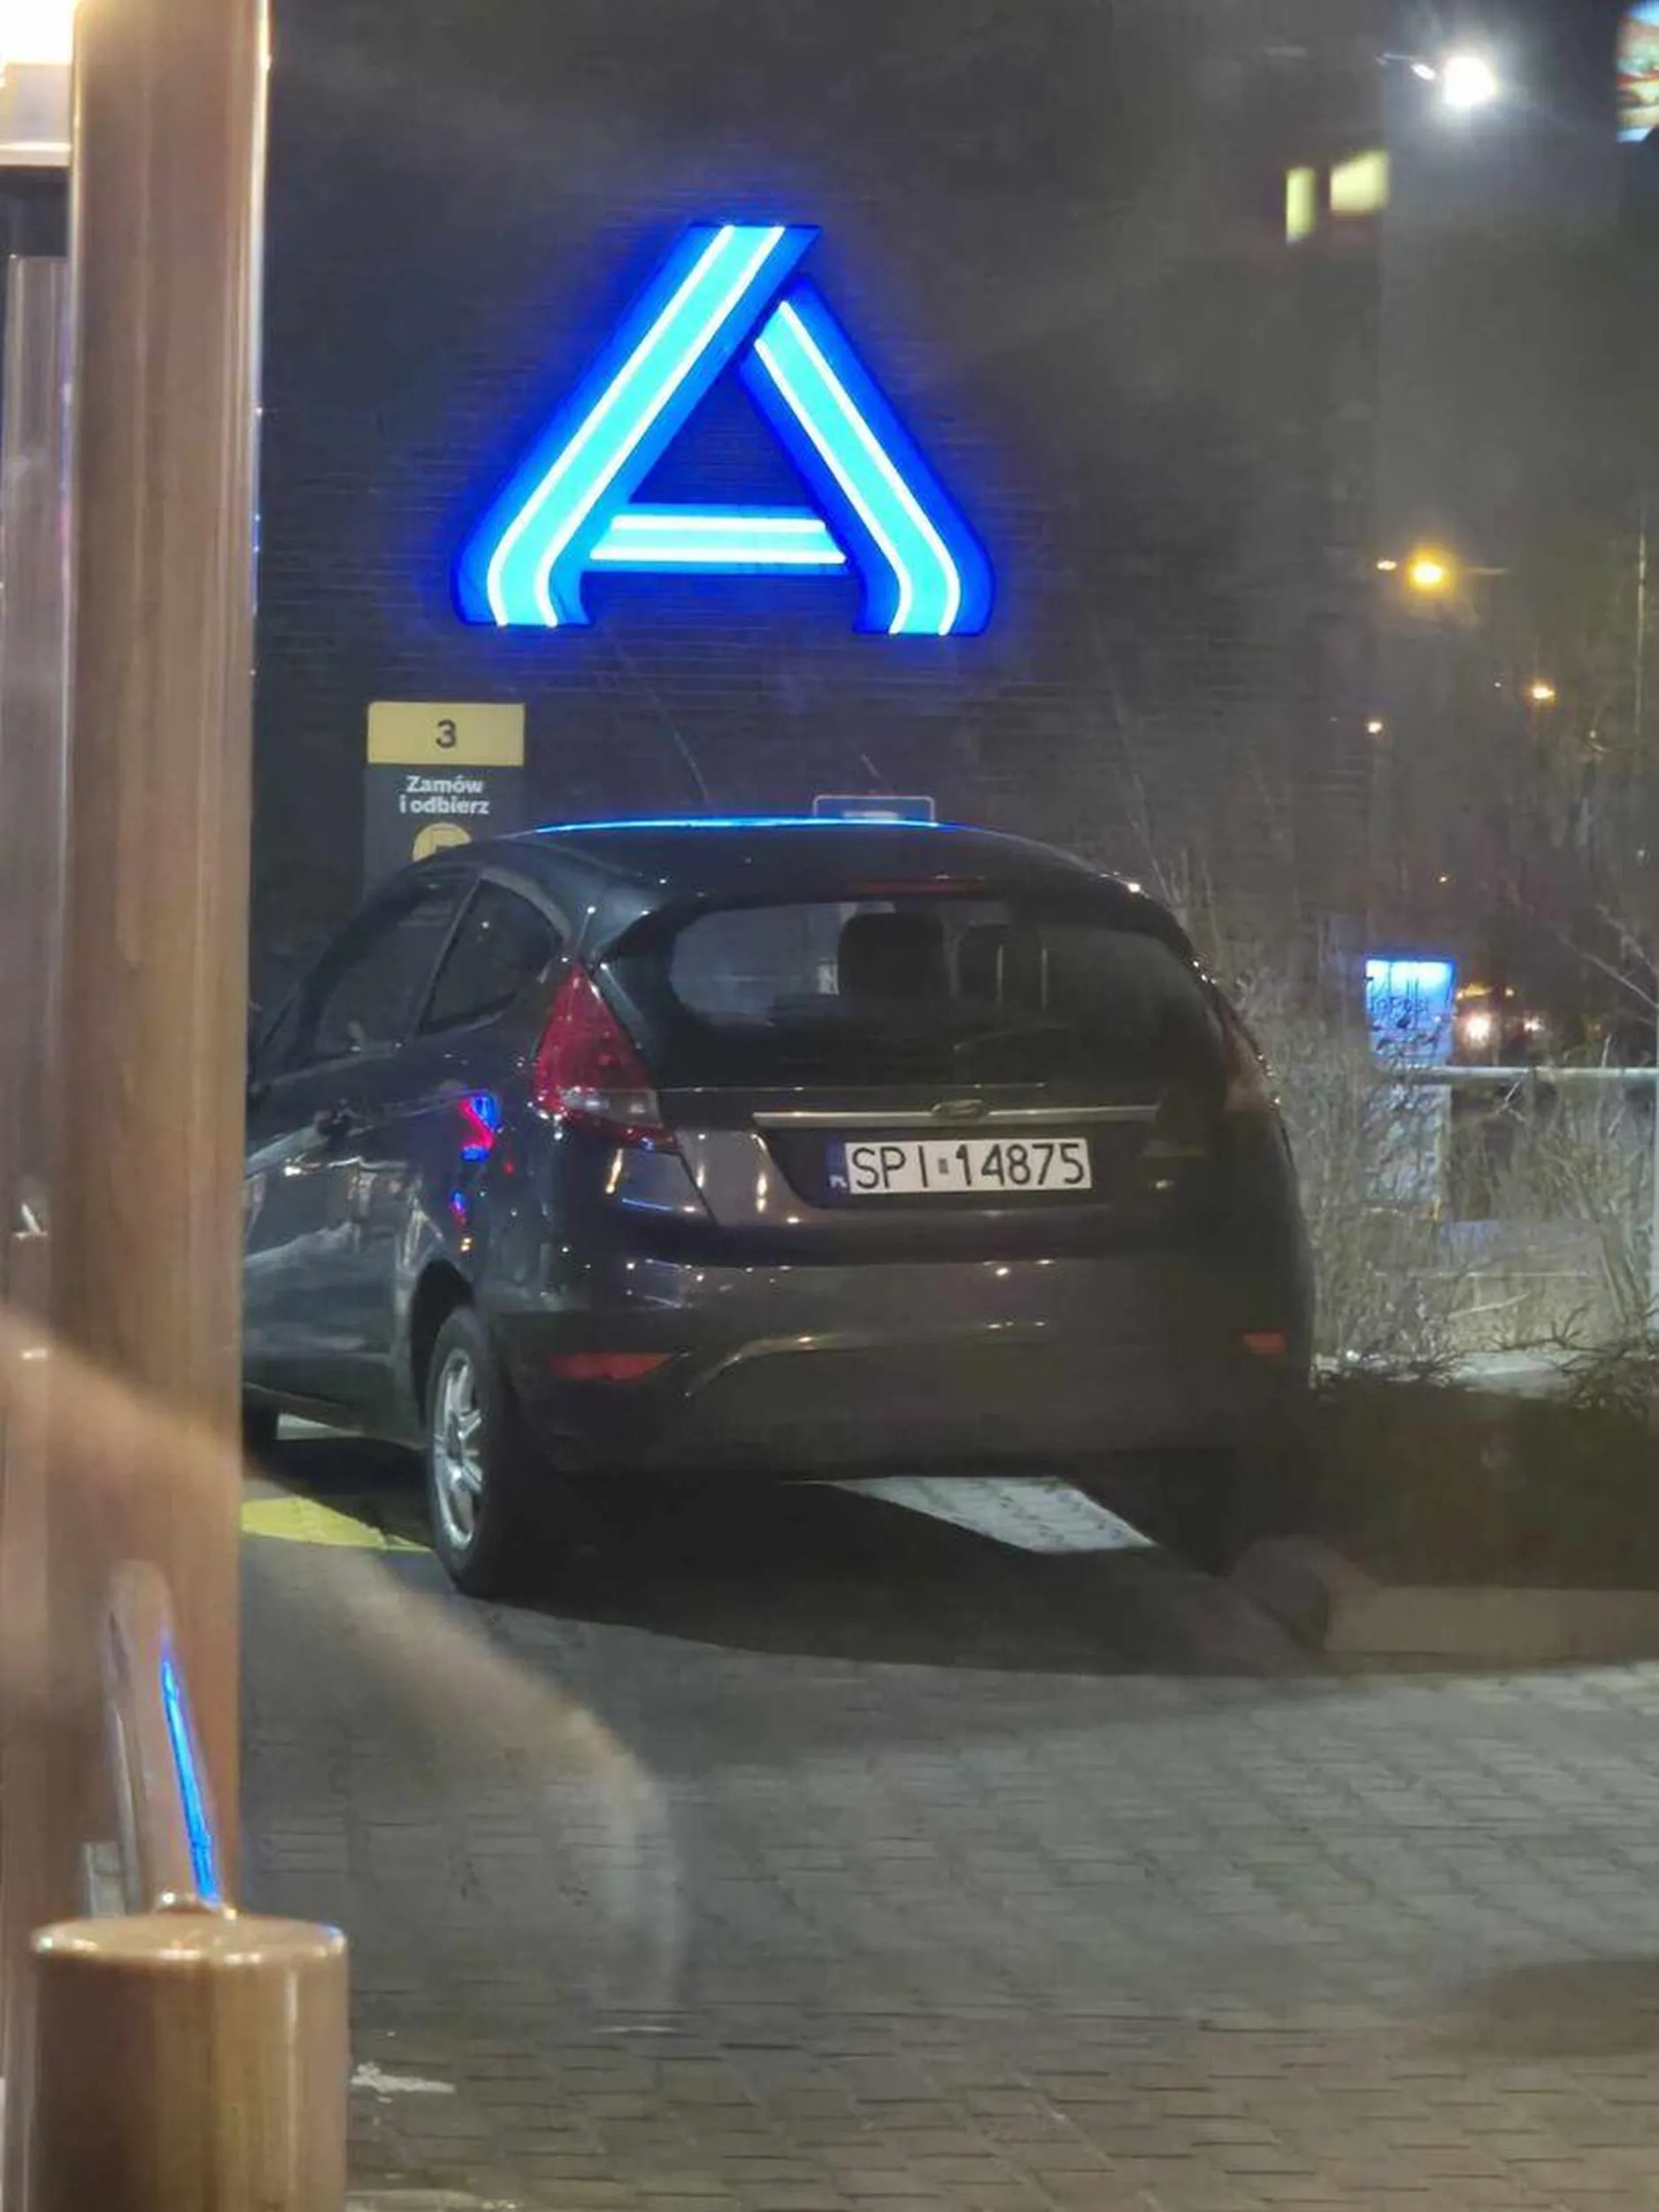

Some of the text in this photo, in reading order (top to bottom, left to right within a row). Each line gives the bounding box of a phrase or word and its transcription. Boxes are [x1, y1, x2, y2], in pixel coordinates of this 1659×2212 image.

[435, 718, 457, 749] 3
[406, 774, 484, 794] Zamów
[400, 794, 489, 814] i odbierz
[851, 1142, 1085, 1189] SPI 14875
